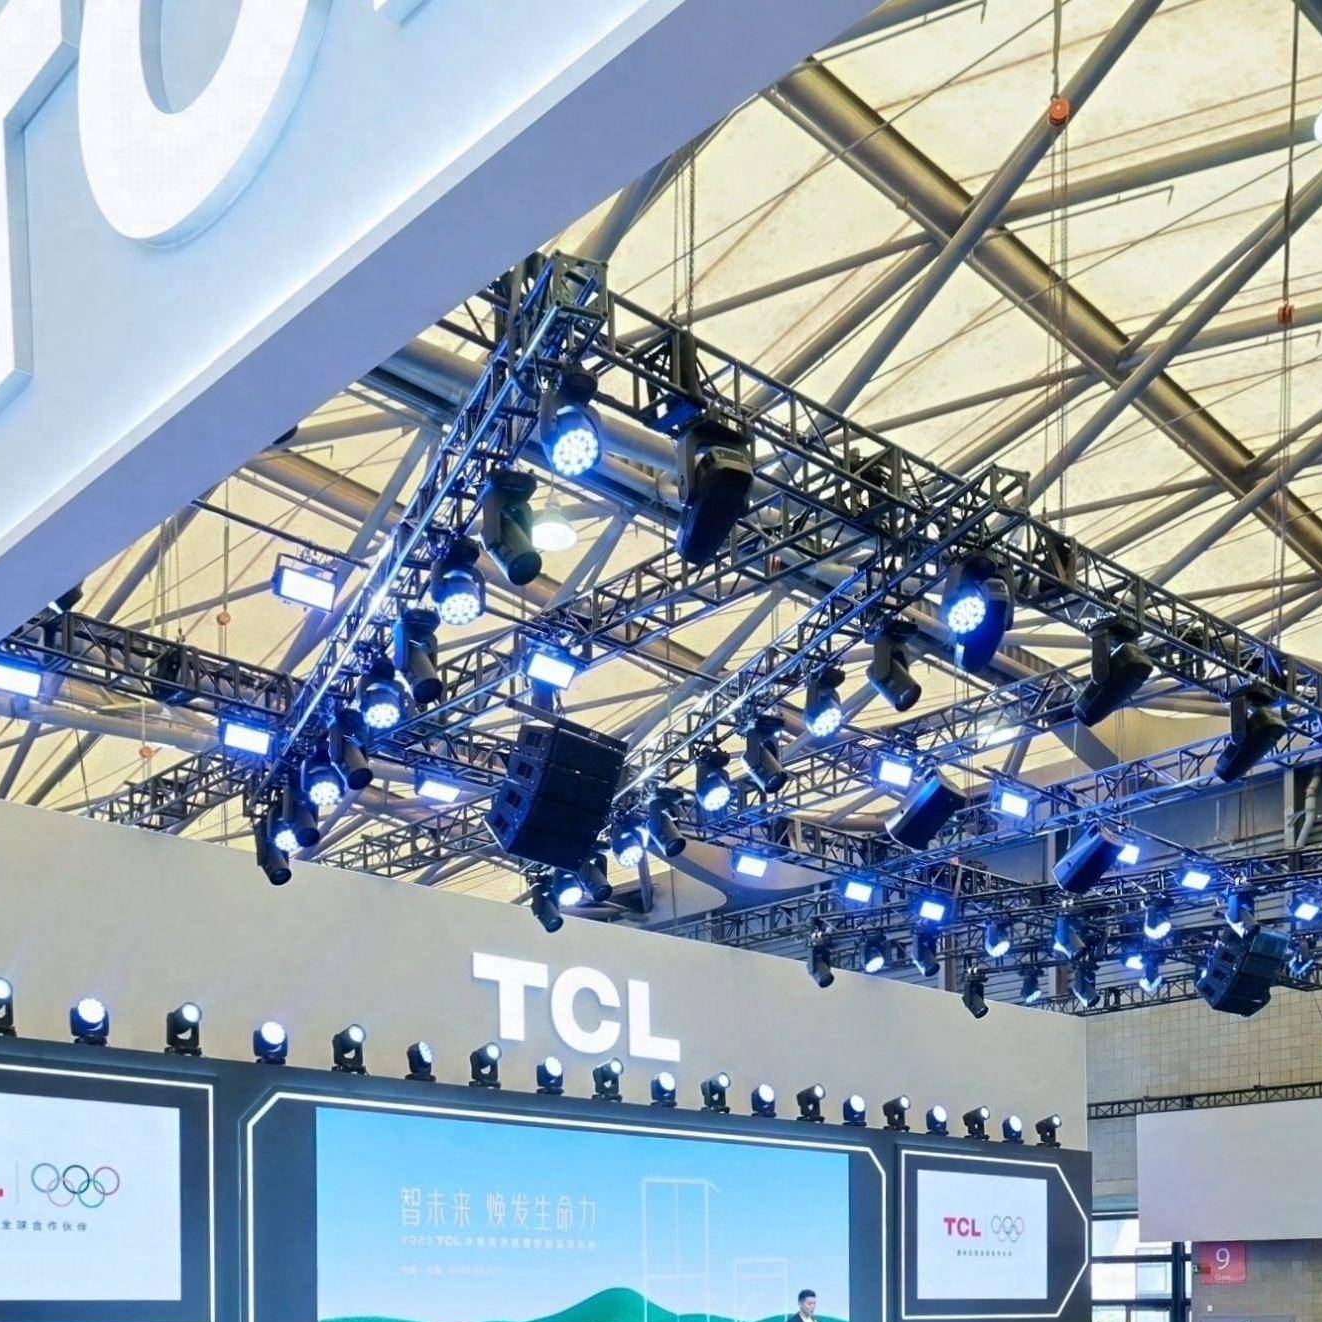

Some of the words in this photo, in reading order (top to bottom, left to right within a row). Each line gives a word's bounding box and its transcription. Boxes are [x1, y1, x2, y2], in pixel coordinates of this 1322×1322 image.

[472, 952, 681, 1062] TCL
[400, 1186, 472, 1228] 智未来
[486, 1191, 598, 1233] 焕发生命力
[943, 1216, 981, 1237] TCL
[1215, 1247, 1230, 1271] 9
